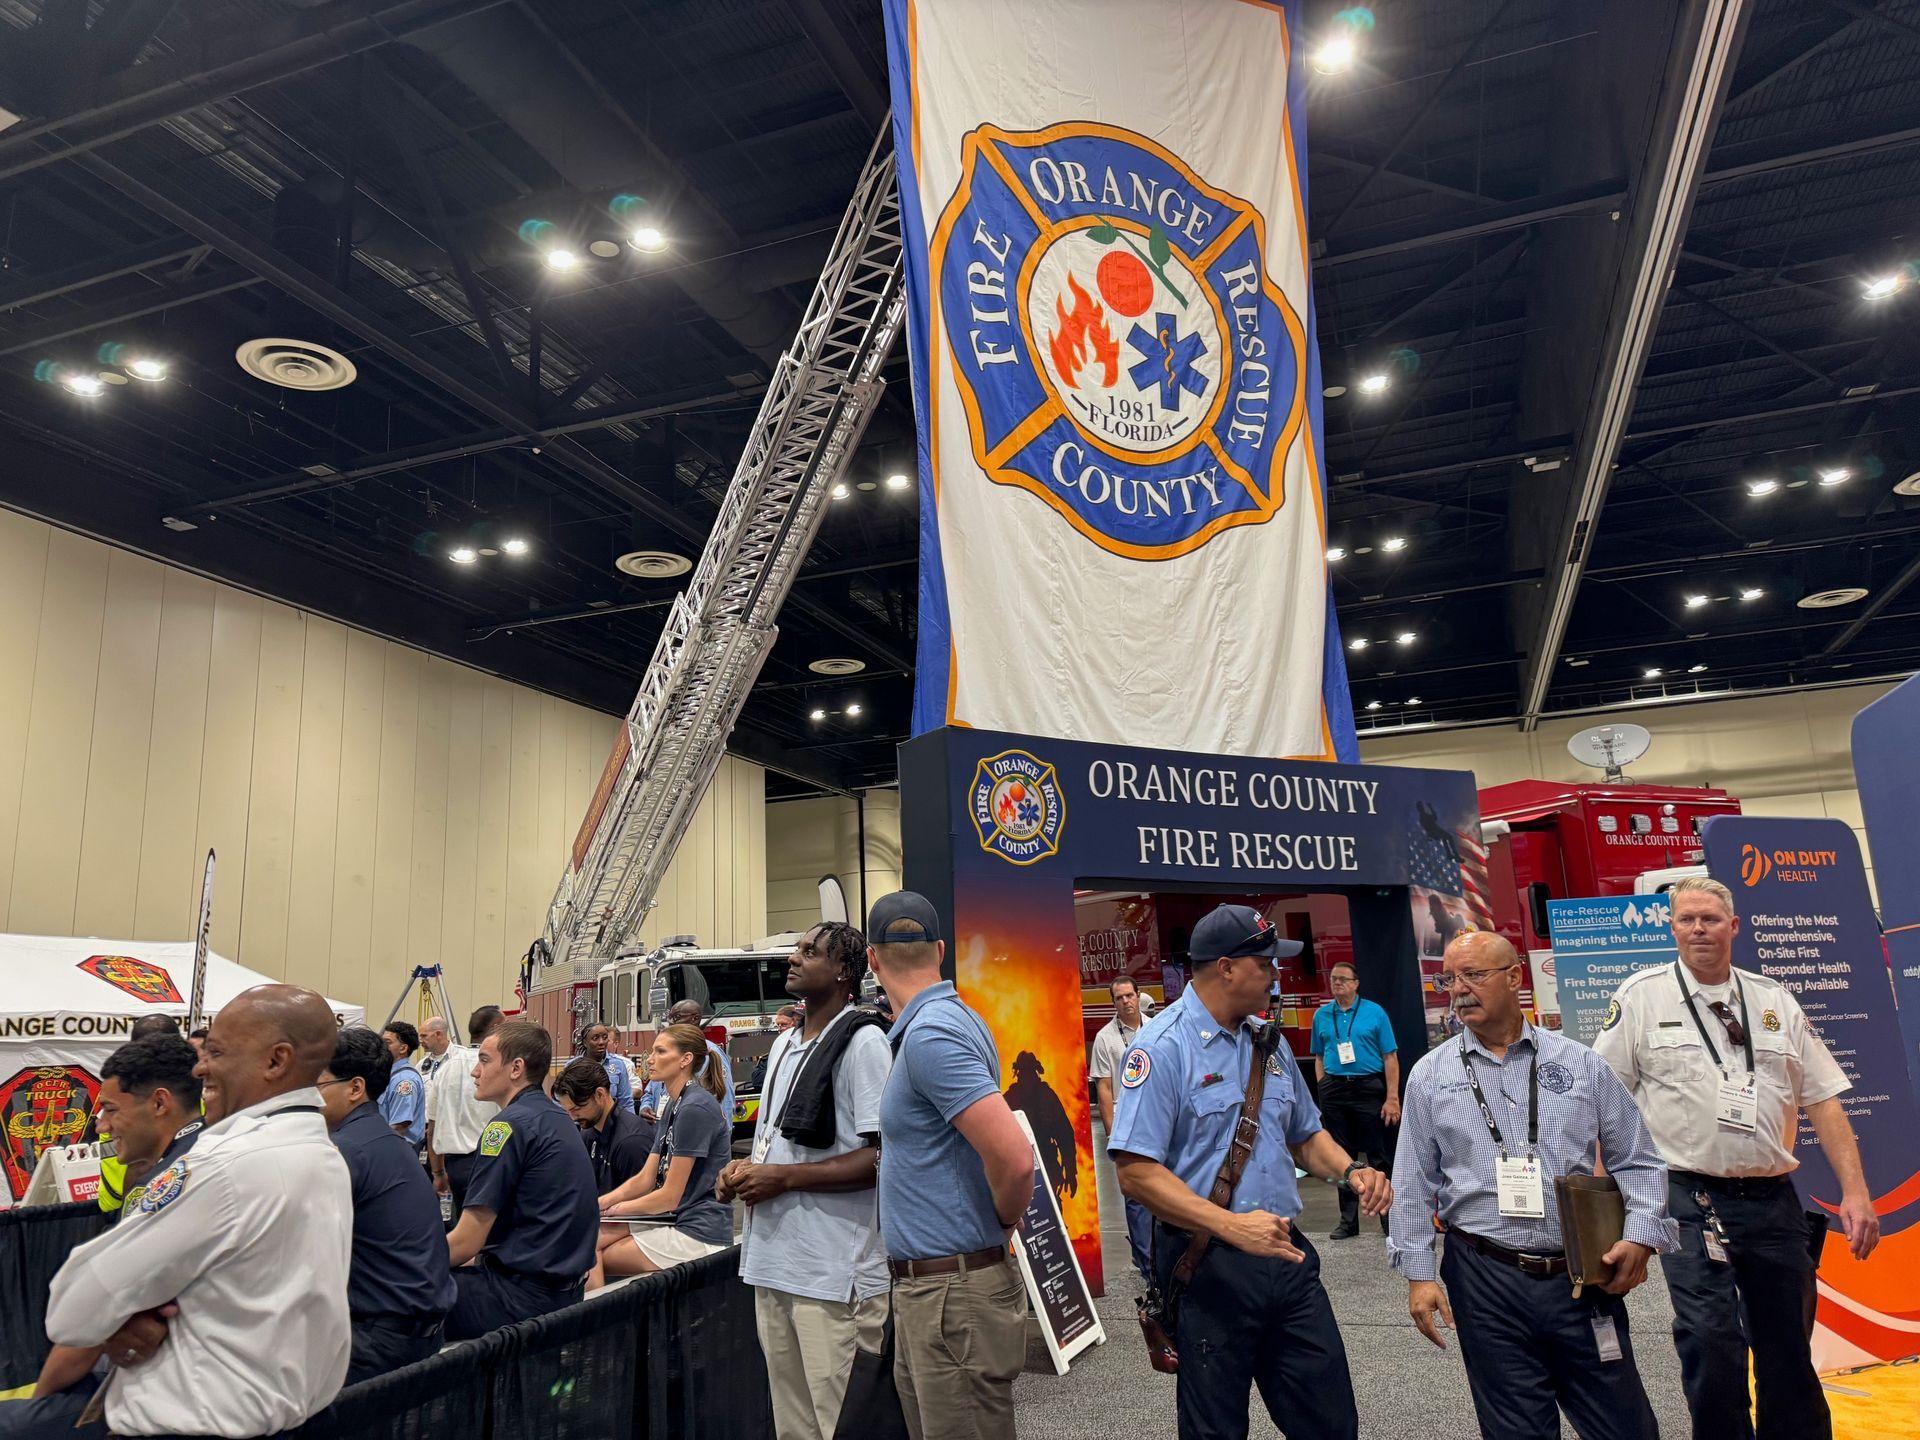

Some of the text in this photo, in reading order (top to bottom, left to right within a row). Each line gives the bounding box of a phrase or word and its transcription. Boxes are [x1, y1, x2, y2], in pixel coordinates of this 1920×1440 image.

[1029, 156, 1214, 245] ORANGE
[966, 218, 1019, 372] FIRE
[1220, 258, 1271, 450] RESCUE
[1107, 394, 1156, 423] 1981
[1087, 407, 1175, 443] FLORIDA
[1051, 441, 1224, 518] COUNTY
[994, 759, 1040, 780] ORANGE
[1088, 759, 1379, 815] ORANGE COUNTY
[976, 783, 992, 825] FIRE
[1041, 782, 1058, 835] RESCUE
[1008, 825, 1033, 836] FLORIDA
[998, 834, 1040, 855] COUNTY
[1605, 834, 1703, 847] ORANGE COUNTY FIRE
[1137, 826, 1359, 872] FIRE RESCUE
[1773, 850, 1836, 866] ON DUTY
[1777, 870, 1817, 882] HEALTH
[1552, 906, 1620, 917] Fire-Rescue
[1553, 914, 1621, 927] International
[1751, 914, 1839, 928] Offering the Most
[1089, 929, 1139, 951] COUNTY
[1555, 932, 1668, 947] Imagining the Future
[1754, 930, 1836, 944] Comprehensive,
[1757, 946, 1820, 959] On-Site First
[1081, 952, 1127, 972] RESCUE
[1587, 962, 1628, 974] Orange
[1761, 961, 1851, 977] Responder Health
[1564, 977, 1586, 988] Fire
[1804, 977, 1849, 991] Available
[1575, 990, 1599, 1001] Live
[1576, 1008, 1609, 1016] WEDNES
[24, 1089, 78, 1101] TRUCK
[1839, 1097, 1857, 1105] hrough
[73, 1180, 99, 1196] EXERC
